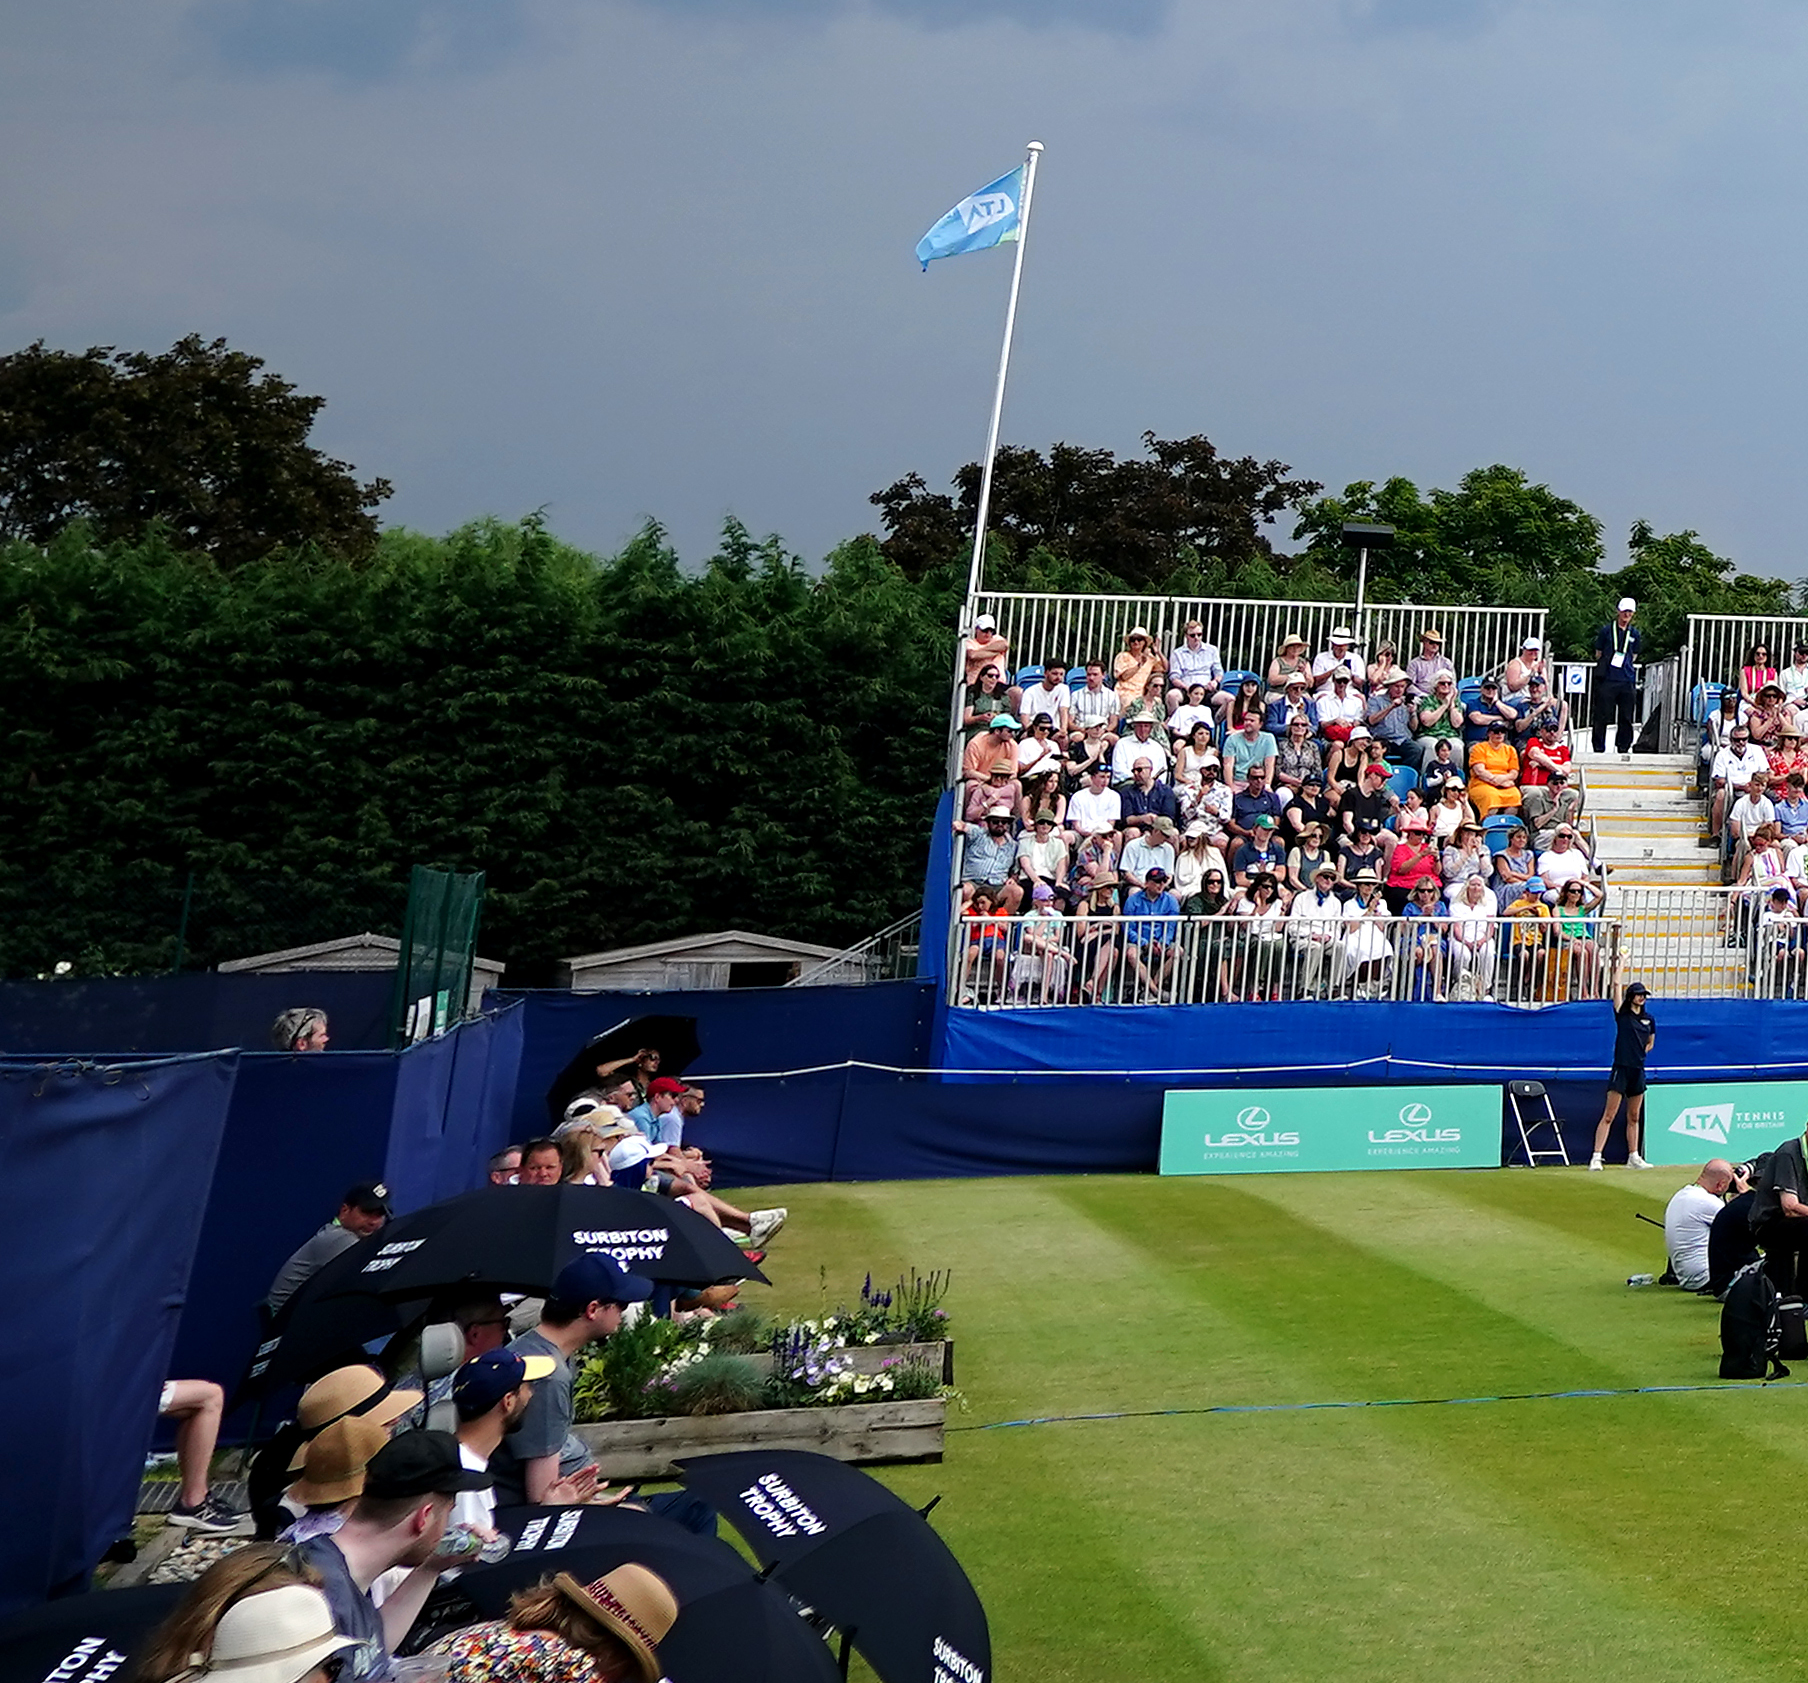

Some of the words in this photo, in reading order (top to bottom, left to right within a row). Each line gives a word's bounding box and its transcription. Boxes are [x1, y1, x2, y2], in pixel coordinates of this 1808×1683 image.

[1685, 1115, 1728, 1132] LTA
[1735, 1111, 1785, 1122] TENNIS
[1204, 1131, 1301, 1147] LEXUS
[1367, 1127, 1461, 1144] LEXUS
[573, 1227, 670, 1244] SURBITON
[585, 1245, 666, 1261] OPHY
[740, 1486, 798, 1537] TROPHY
[758, 1473, 828, 1535] SURBITON
